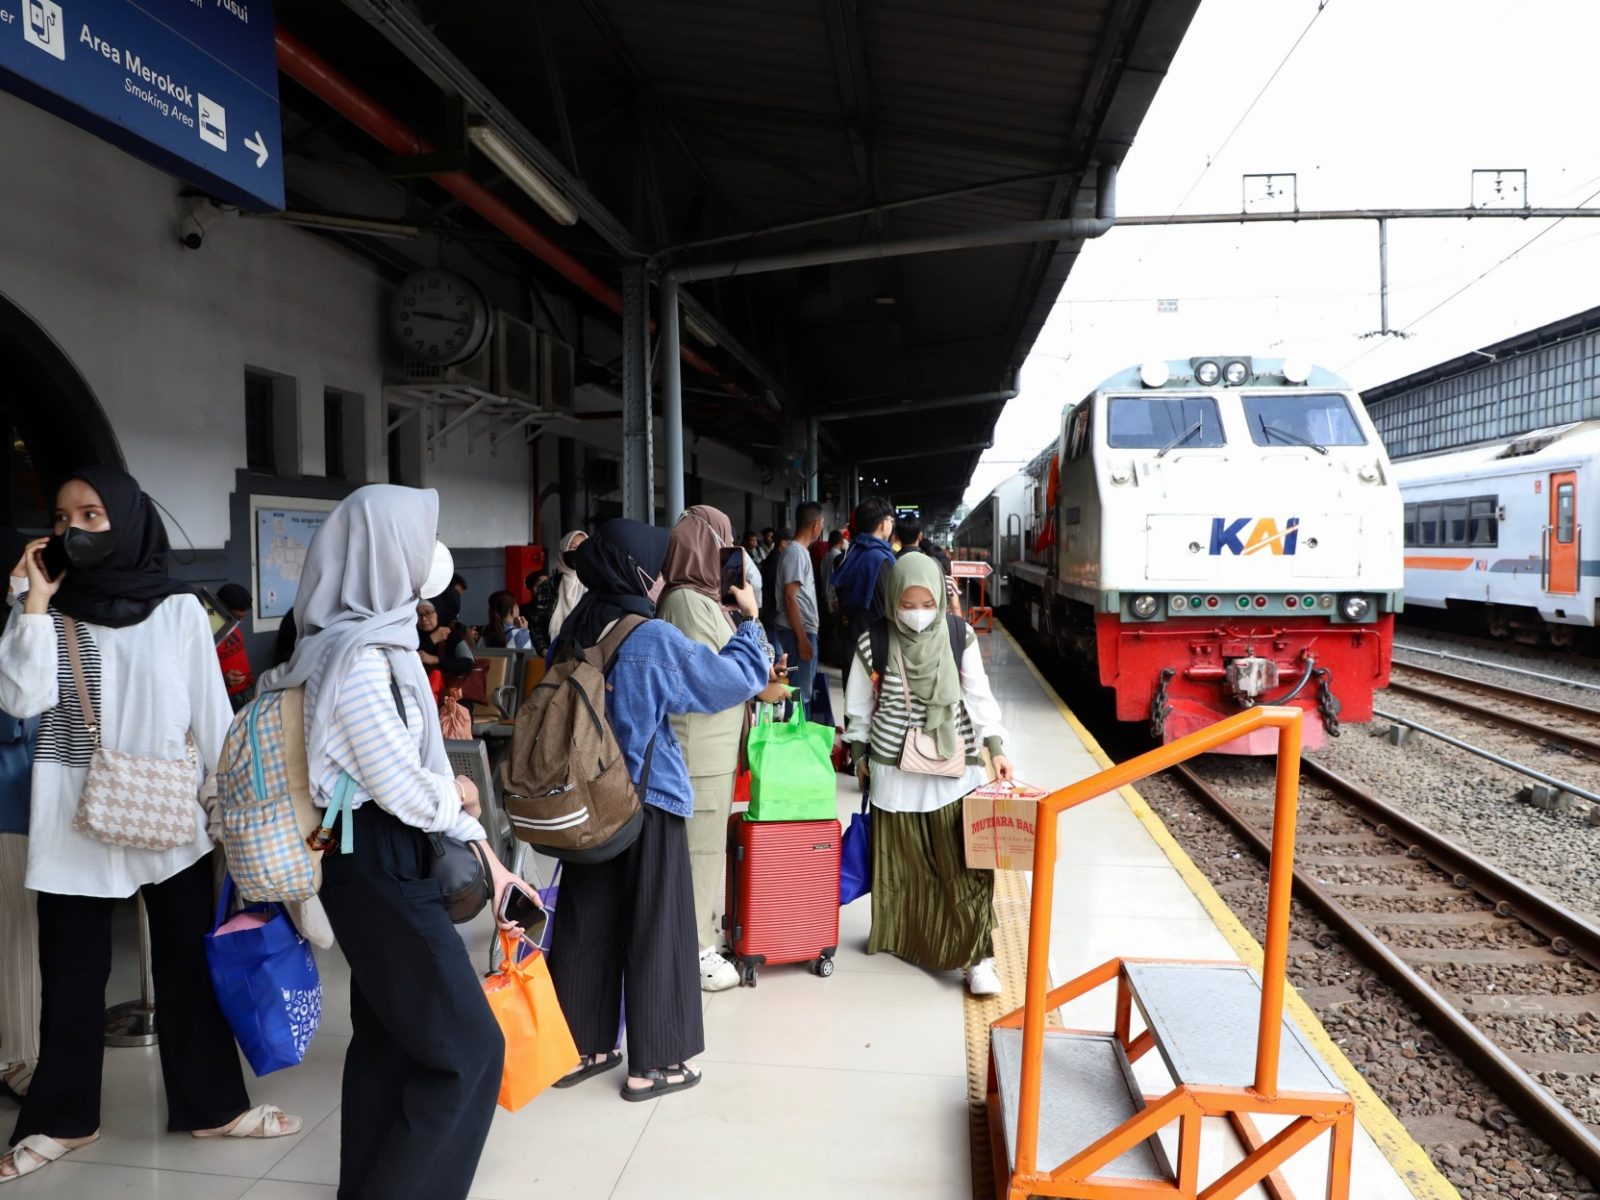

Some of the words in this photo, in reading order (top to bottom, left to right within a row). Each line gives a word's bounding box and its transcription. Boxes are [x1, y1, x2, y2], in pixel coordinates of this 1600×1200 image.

[79, 23, 121, 65] Area
[125, 49, 193, 108] Merokok
[124, 78, 169, 117] Smoking
[171, 108, 194, 129] Area
[1208, 517, 1300, 556] KAI
